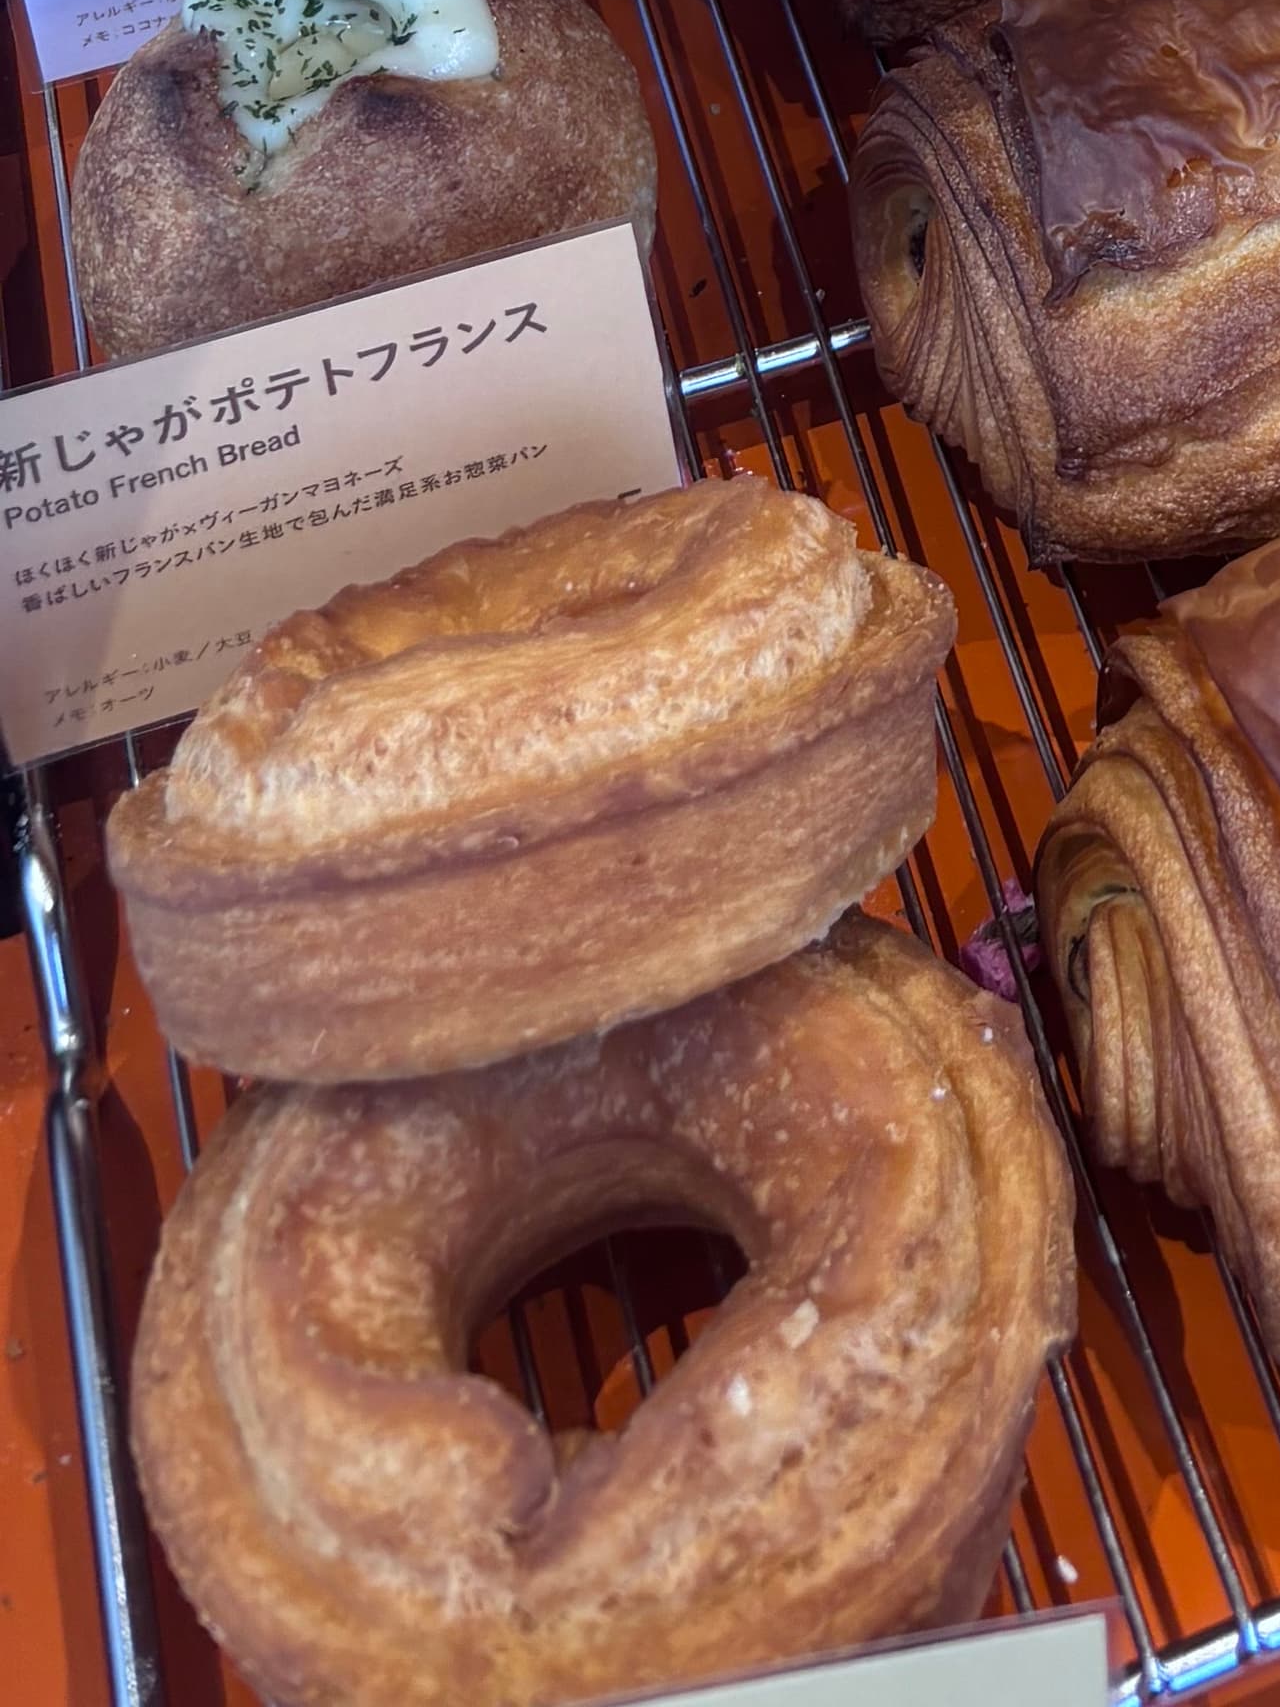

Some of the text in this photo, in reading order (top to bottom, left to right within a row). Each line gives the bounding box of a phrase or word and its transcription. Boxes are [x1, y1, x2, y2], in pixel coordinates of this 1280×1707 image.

[0, 300, 549, 489] 新じゃがポテトフランス
[3, 425, 302, 531] Potato French Bread
